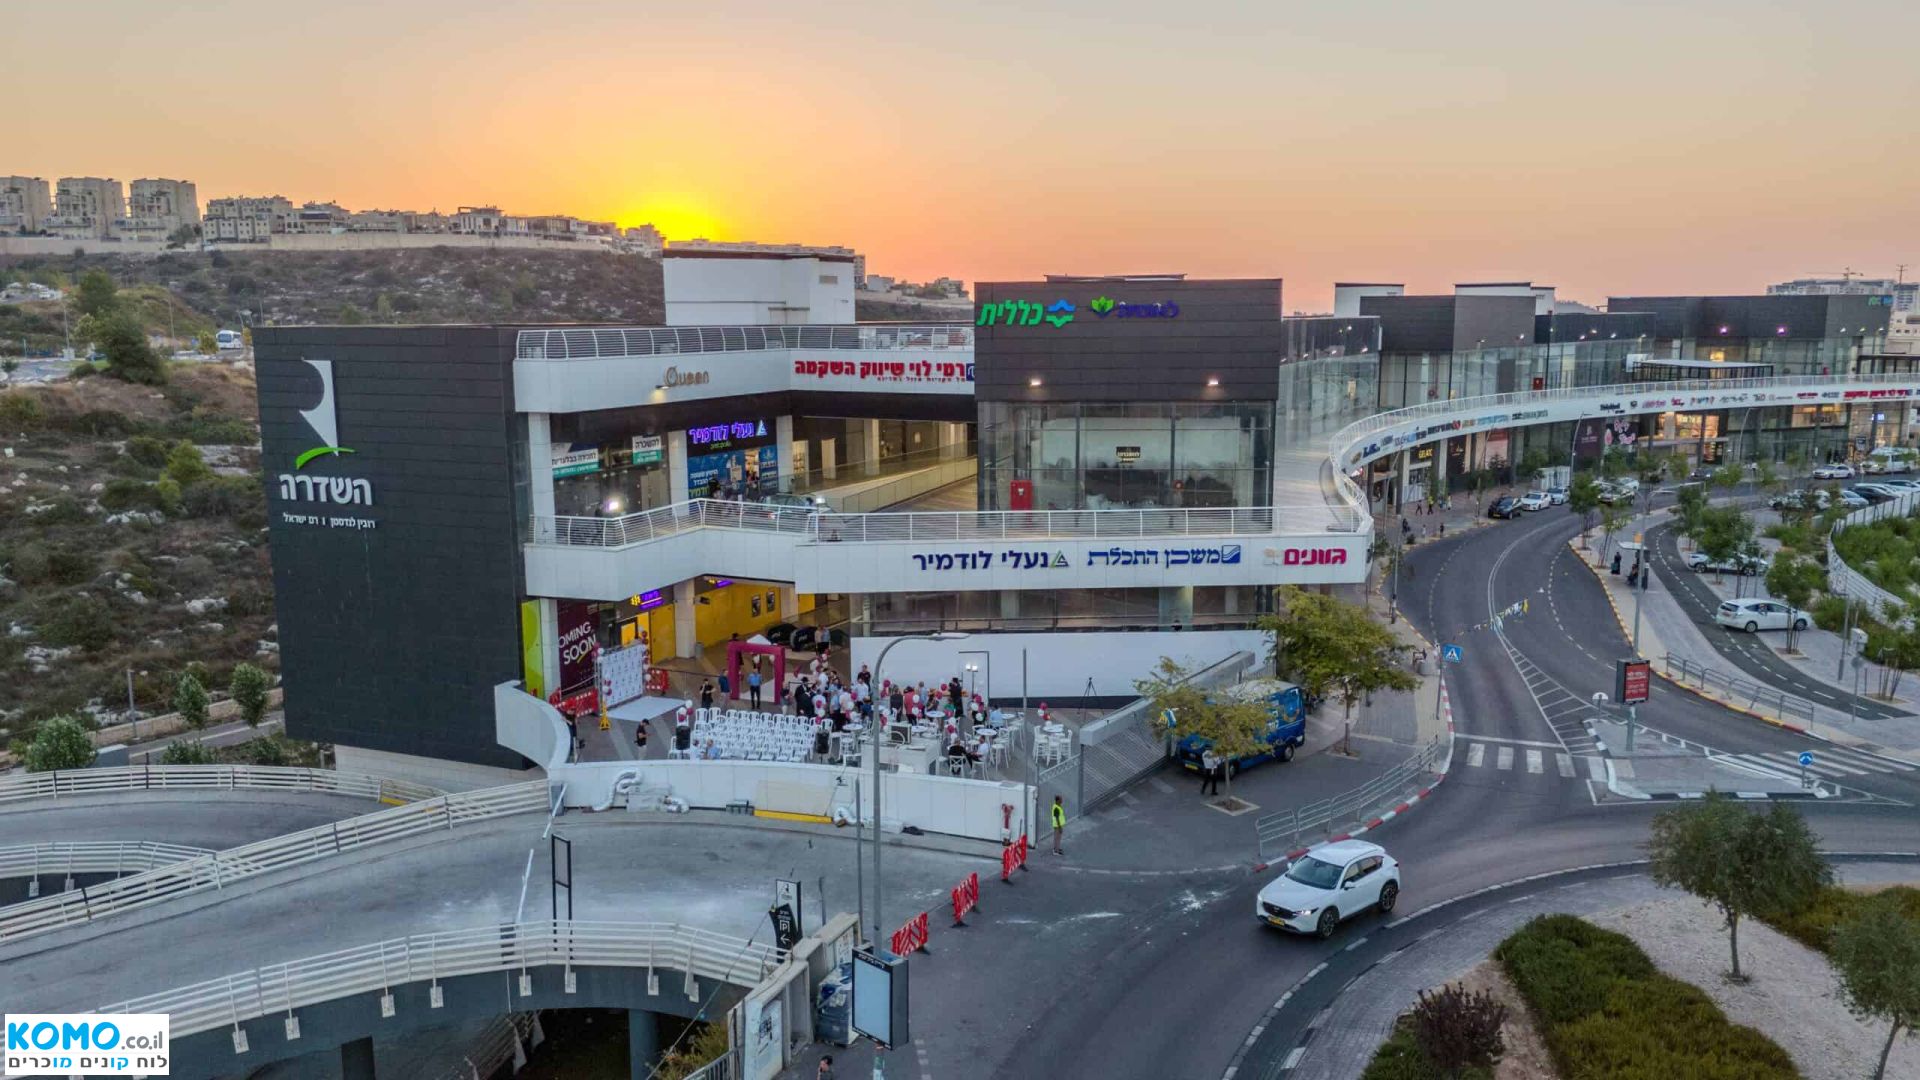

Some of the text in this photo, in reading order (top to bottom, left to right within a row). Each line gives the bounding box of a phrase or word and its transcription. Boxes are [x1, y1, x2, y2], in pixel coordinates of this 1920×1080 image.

[976, 299, 1044, 326] כללית
[664, 366, 710, 387] Queen
[794, 360, 966, 379] רמי לוי שיווק השקמה
[688, 422, 755, 444] נעלי לודמיר
[279, 474, 373, 506] השדרה
[282, 512, 307, 524] ישראל
[912, 550, 1049, 571] נעלי לודמיר
[1087, 547, 1221, 569] משכן התכלת
[1284, 548, 1347, 566] גוונים
[558, 621, 592, 649] OMING
[563, 633, 597, 666] SOON
